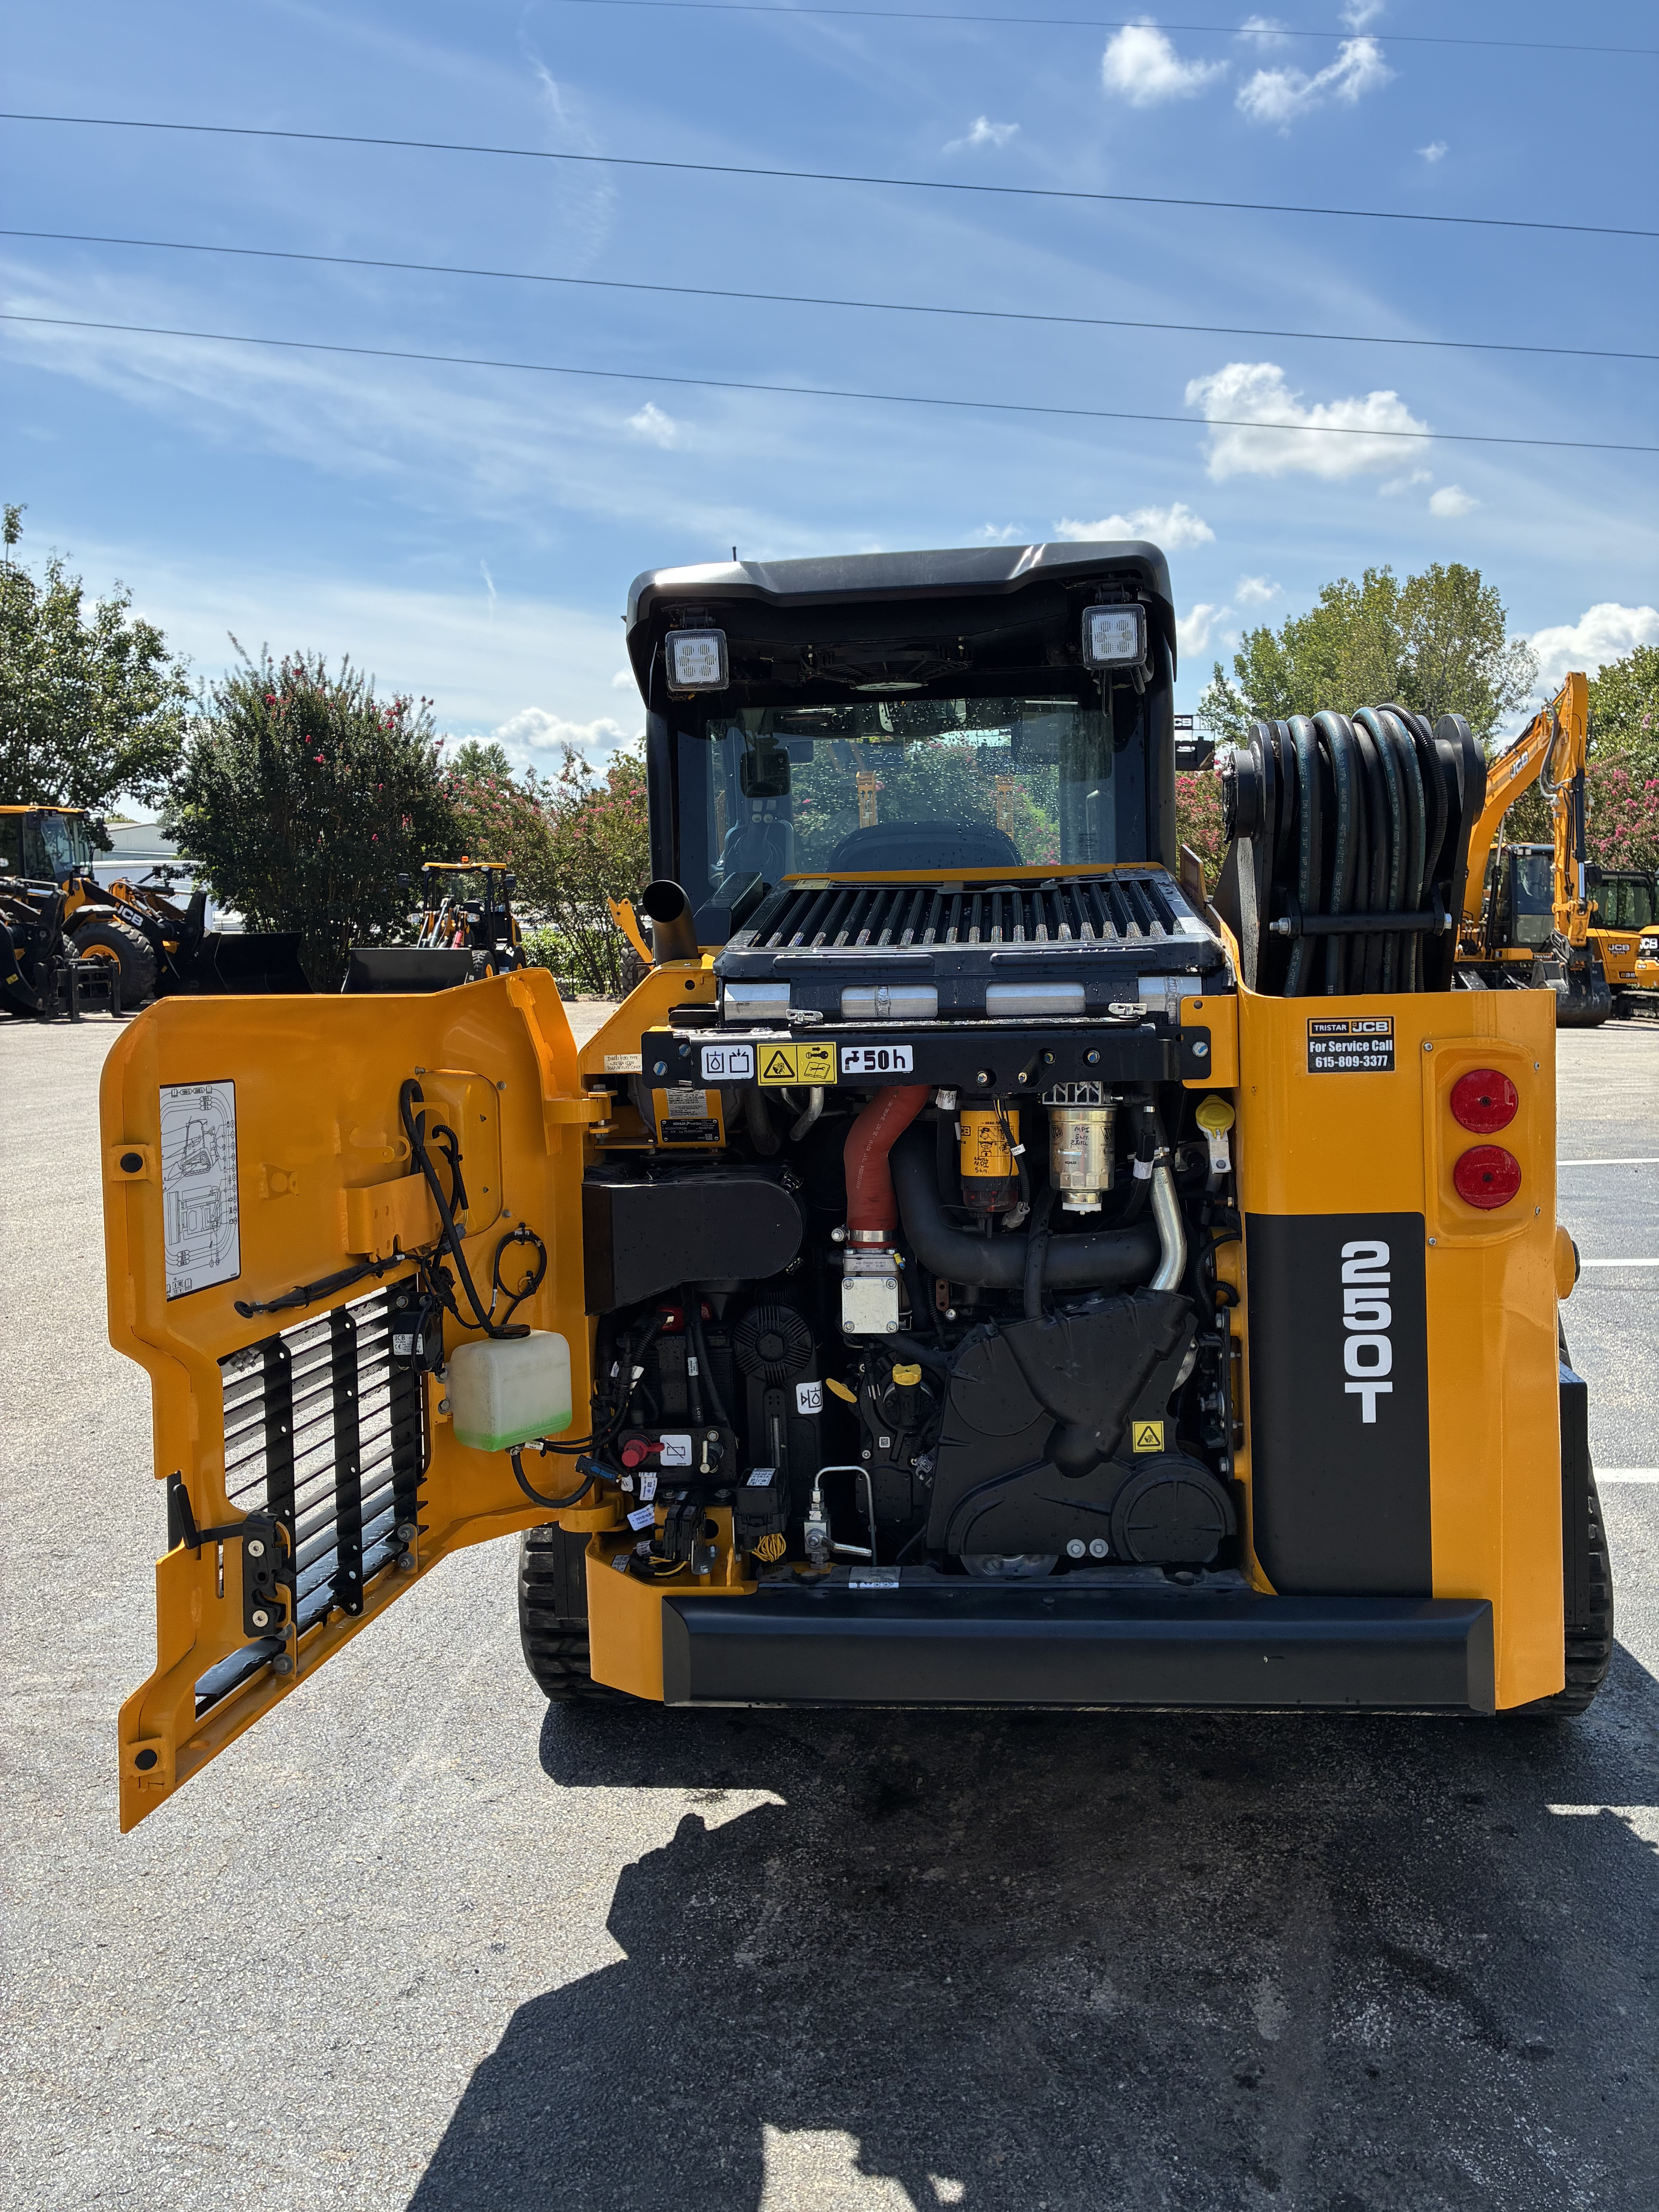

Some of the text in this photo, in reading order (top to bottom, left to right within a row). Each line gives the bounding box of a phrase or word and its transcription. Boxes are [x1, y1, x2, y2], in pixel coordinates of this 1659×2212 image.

[1174, 718, 1192, 726] CB
[1511, 751, 1528, 779] JCB
[115, 905, 143, 927] JCB
[1640, 938, 1658, 949] JCB
[1352, 1022, 1388, 1032] JCB
[1310, 1039, 1393, 1053] For Service Call
[1315, 1055, 1388, 1068] 615-809-3377
[961, 1126, 970, 1135] CB
[1052, 1126, 1062, 1140] JCB
[1341, 1240, 1393, 1423] 250T
